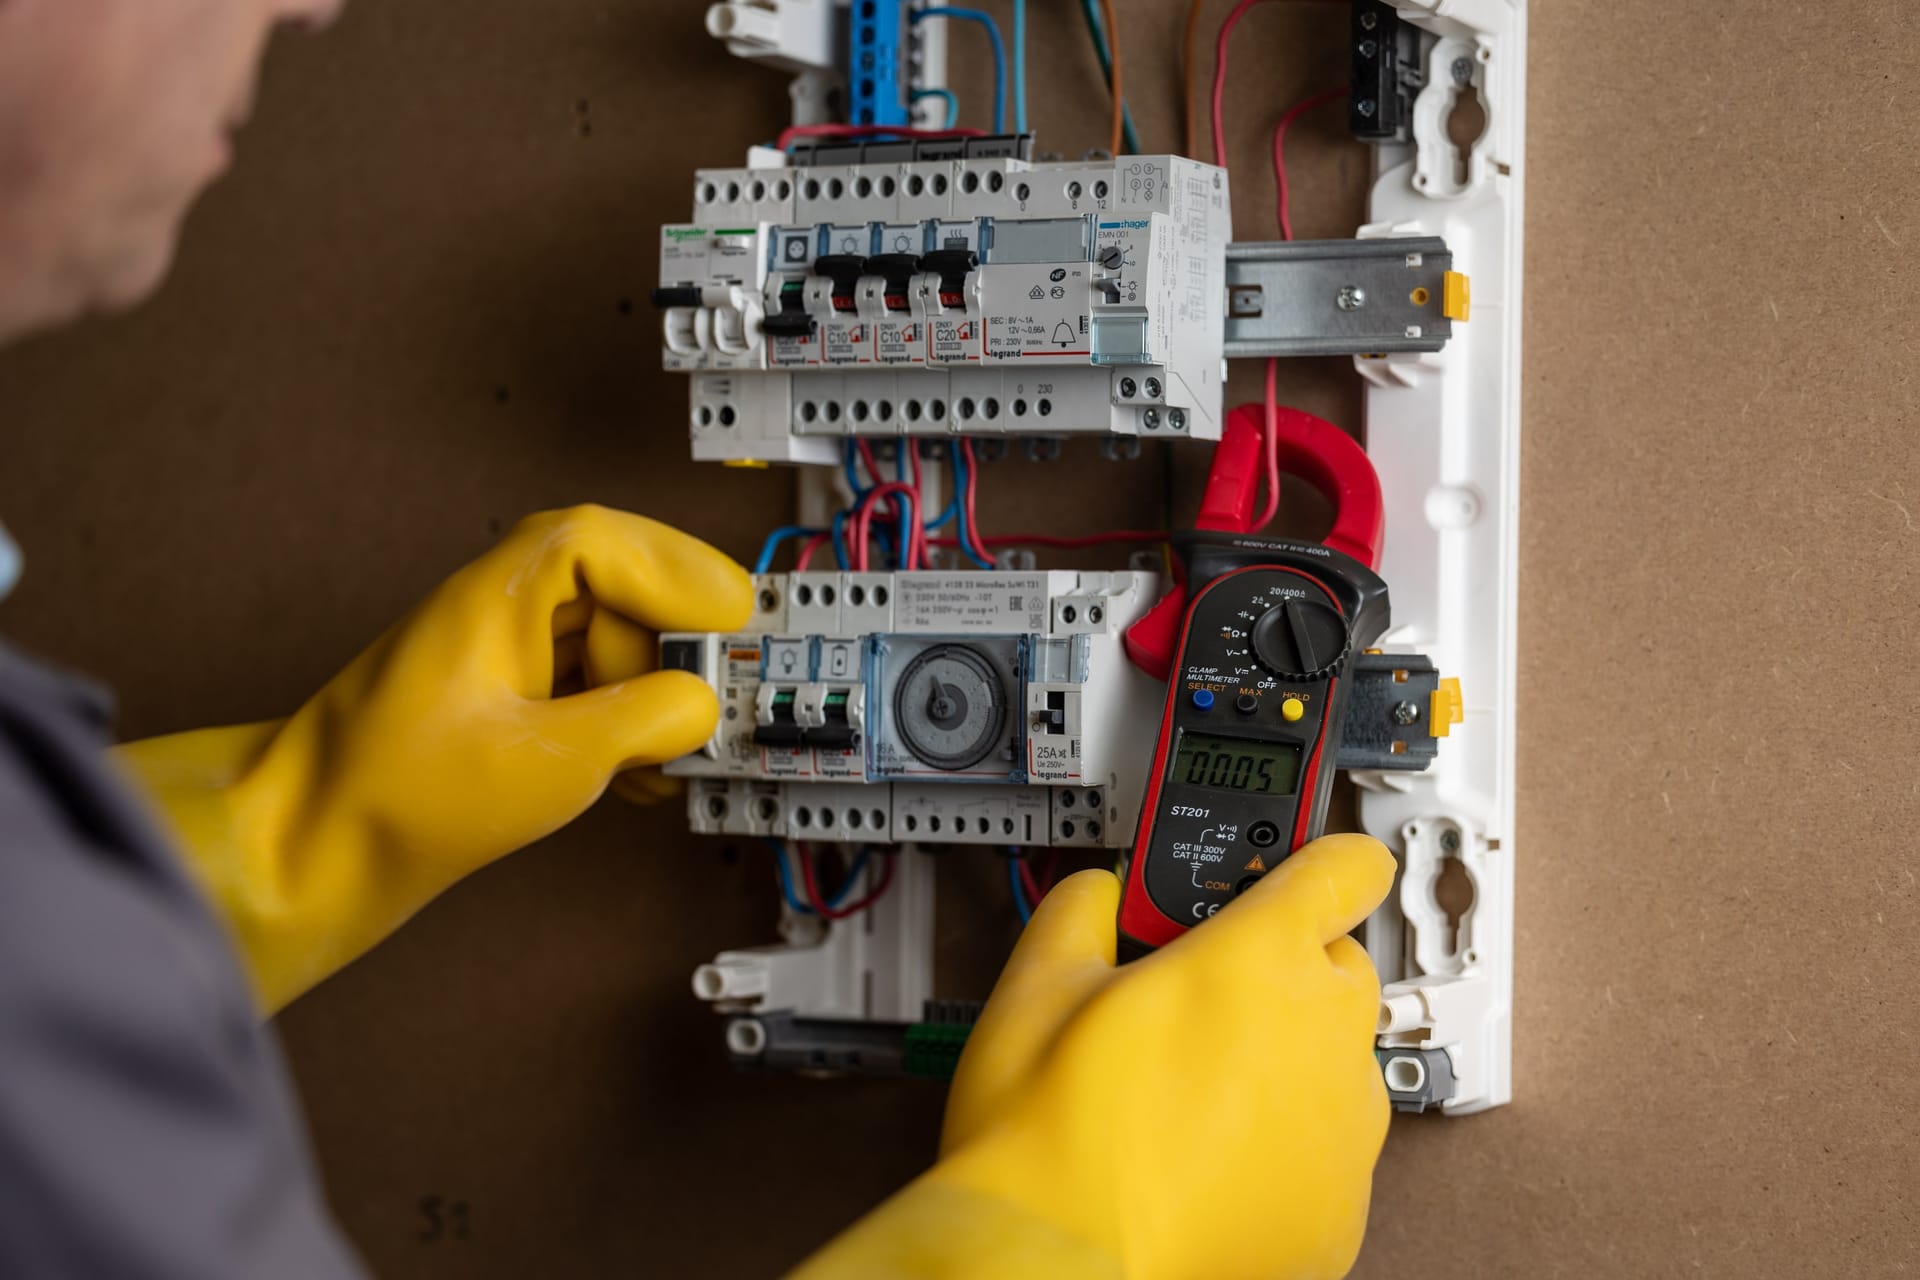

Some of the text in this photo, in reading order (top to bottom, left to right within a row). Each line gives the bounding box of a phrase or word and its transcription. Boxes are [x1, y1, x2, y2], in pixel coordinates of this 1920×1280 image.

[1097, 200, 1106, 209] 12
[1098, 231, 1115, 239] EMN
[990, 317, 1003, 325] SEC
[936, 329, 956, 341] C20
[1008, 327, 1020, 335] 12V
[827, 332, 848, 344] C10
[880, 332, 901, 343] C10
[990, 338, 1002, 346] PRI
[1006, 337, 1022, 346] 230V
[881, 354, 911, 365] legrand
[936, 352, 967, 362] legrand
[990, 349, 1021, 360] legrand
[776, 356, 806, 366] legrand
[828, 355, 858, 365] legrand
[1037, 384, 1053, 394] 230
[1268, 543, 1289, 552] CAT
[1306, 548, 1331, 557] 400A
[1188, 666, 1218, 674] CLAMP
[1186, 673, 1240, 684] MULTIMETER
[1187, 682, 1226, 692] SELECT
[1257, 682, 1277, 690] OFF
[1239, 687, 1263, 696] MAX
[1282, 691, 1310, 701] HOLD
[1037, 747, 1057, 759] 25A
[822, 769, 850, 778] legrand
[1037, 770, 1068, 780] legrand
[1170, 805, 1210, 818] ST201
[1173, 842, 1192, 851] CAT
[1203, 845, 1226, 855] 300V
[1172, 851, 1192, 860] CAT
[1200, 853, 1224, 863] 600V
[1204, 880, 1231, 890] COM
